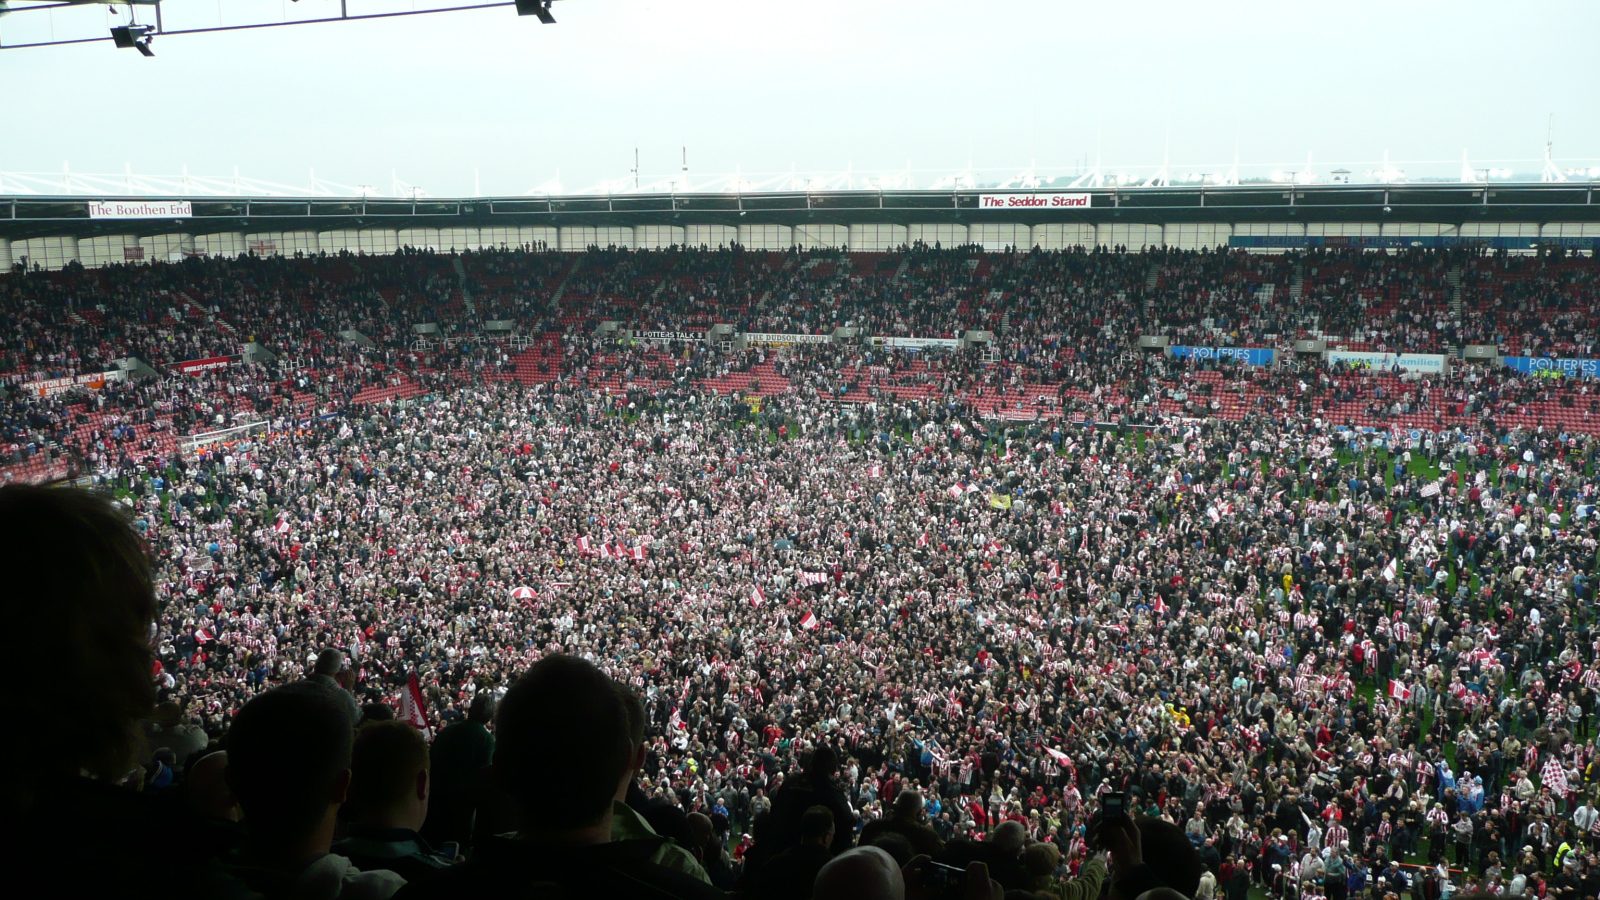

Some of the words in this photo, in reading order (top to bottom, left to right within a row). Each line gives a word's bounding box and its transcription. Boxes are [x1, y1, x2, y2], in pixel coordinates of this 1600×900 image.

[983, 196, 1004, 207] The
[1008, 196, 1047, 207] Seddon
[1051, 196, 1088, 207] Stand
[90, 204, 112, 215] The
[116, 204, 166, 215] Boothen
[170, 203, 191, 215] End
[675, 331, 695, 339] TALK
[766, 334, 797, 342] DUDSON
[800, 334, 827, 343] GROUP
[1192, 347, 1250, 360] POTTERIES
[1331, 355, 1391, 367] Sppoting
[1394, 357, 1440, 366] Families
[1529, 358, 1597, 371] POTTERIES
[60, 373, 101, 386] BEAMOT
